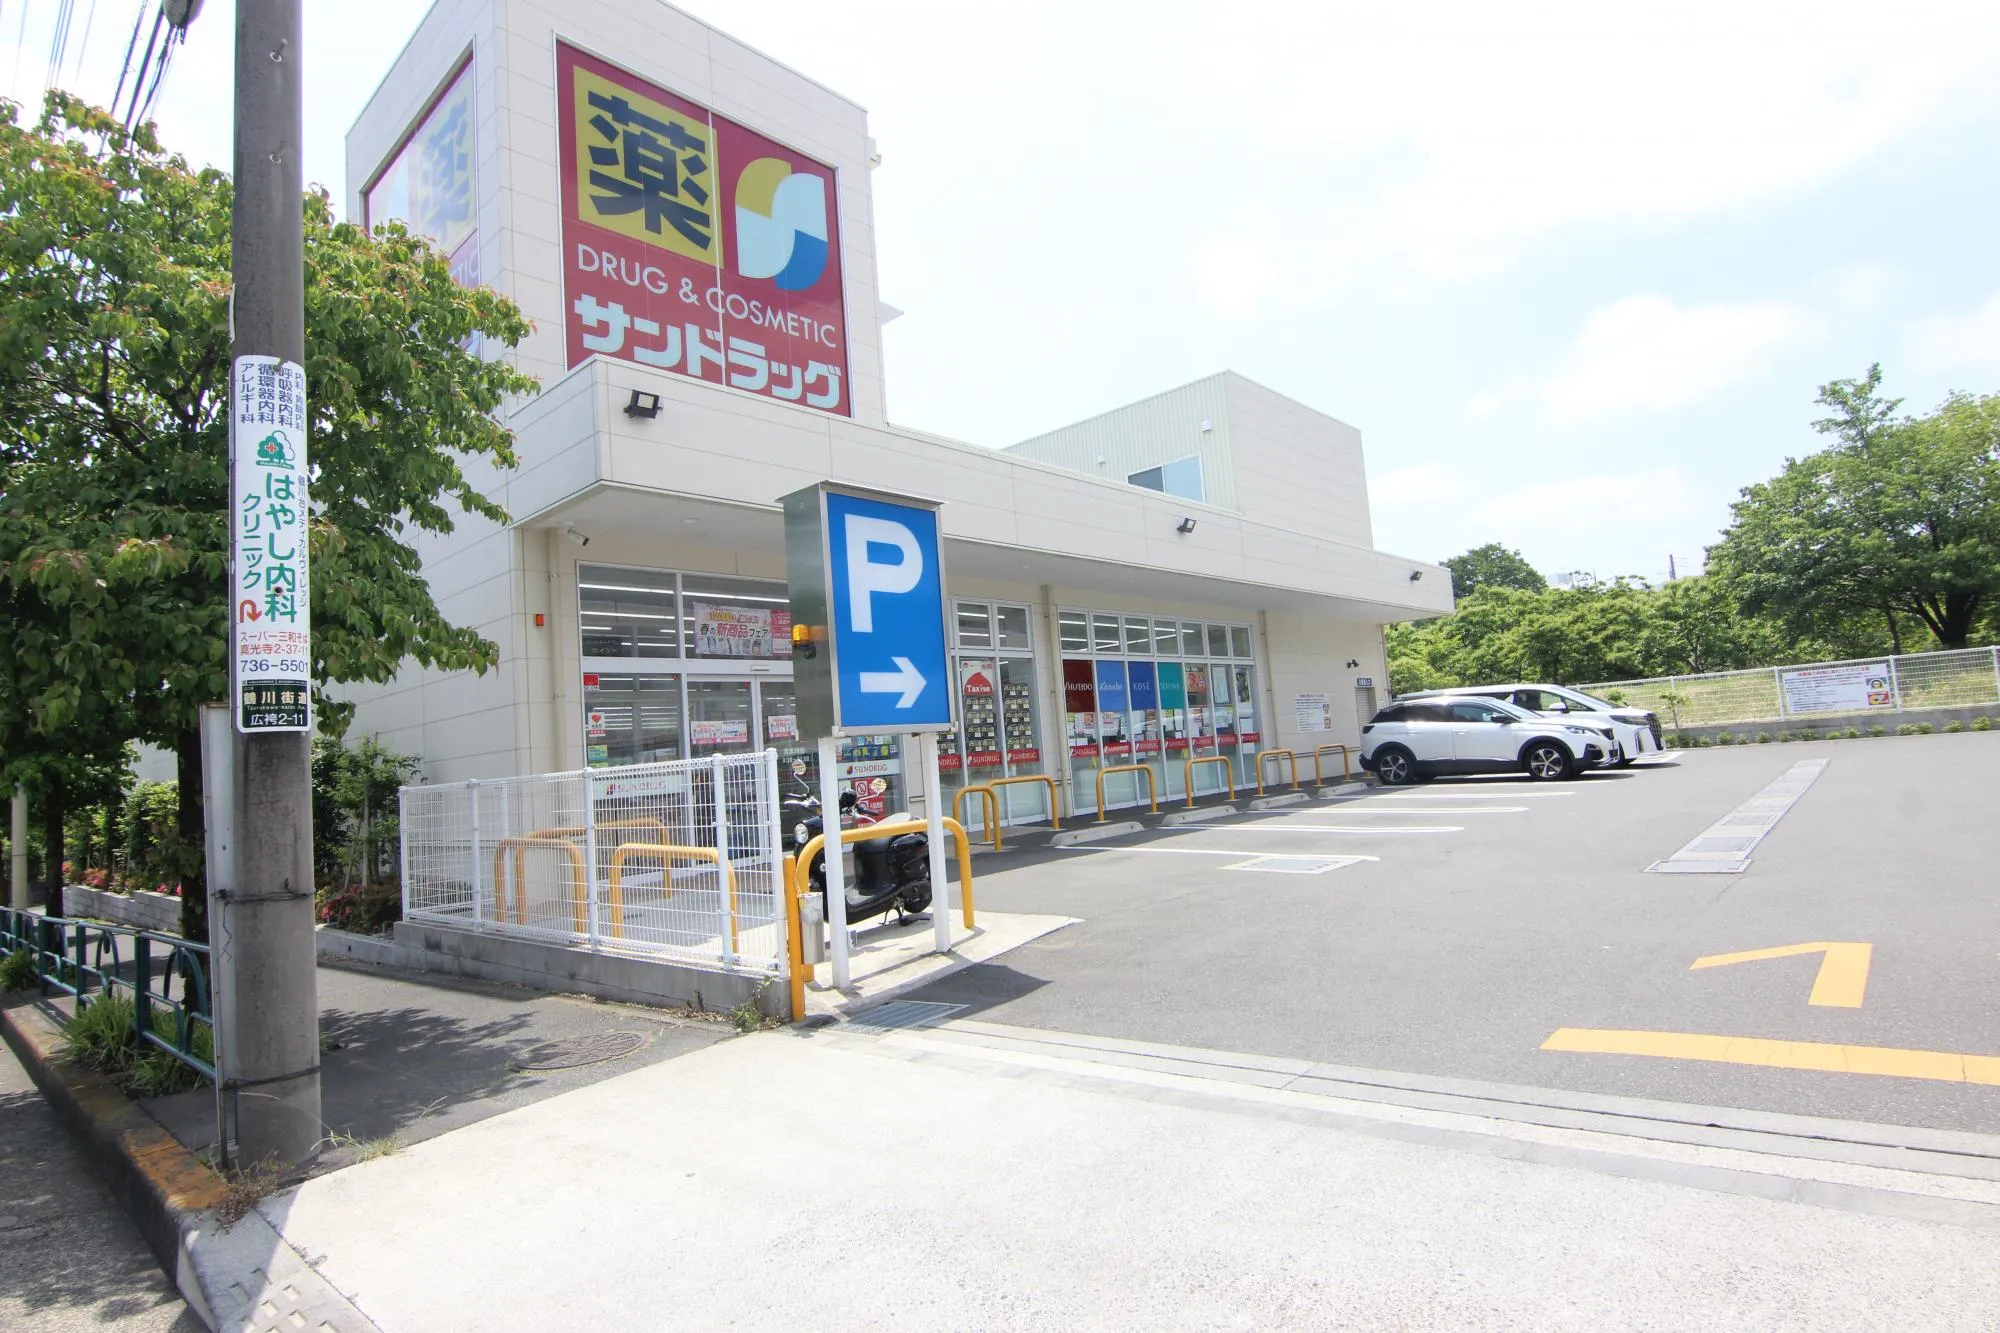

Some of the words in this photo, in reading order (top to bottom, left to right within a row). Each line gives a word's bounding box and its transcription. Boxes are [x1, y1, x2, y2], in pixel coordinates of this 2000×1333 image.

[587, 90, 711, 250] 薬
[577, 243, 669, 295] DRUG
[678, 277, 701, 306] &
[705, 287, 837, 348] COSMETIC
[574, 293, 842, 409] サンドラッグ
[241, 363, 255, 424] アレルギー科
[258, 363, 275, 425] 循環器内科
[279, 367, 293, 428] 呼吸器内科
[242, 493, 263, 589] クリニック
[265, 472, 297, 623] はやし内科
[844, 513, 923, 633] P
[700, 622, 768, 639] 春の新商品フェア
[243, 690, 306, 705] 鶴川街道
[251, 713, 303, 726] 広袴2-11
[854, 764, 888, 774] SUNDRUG
[973, 754, 1000, 763] SUNDRUG
